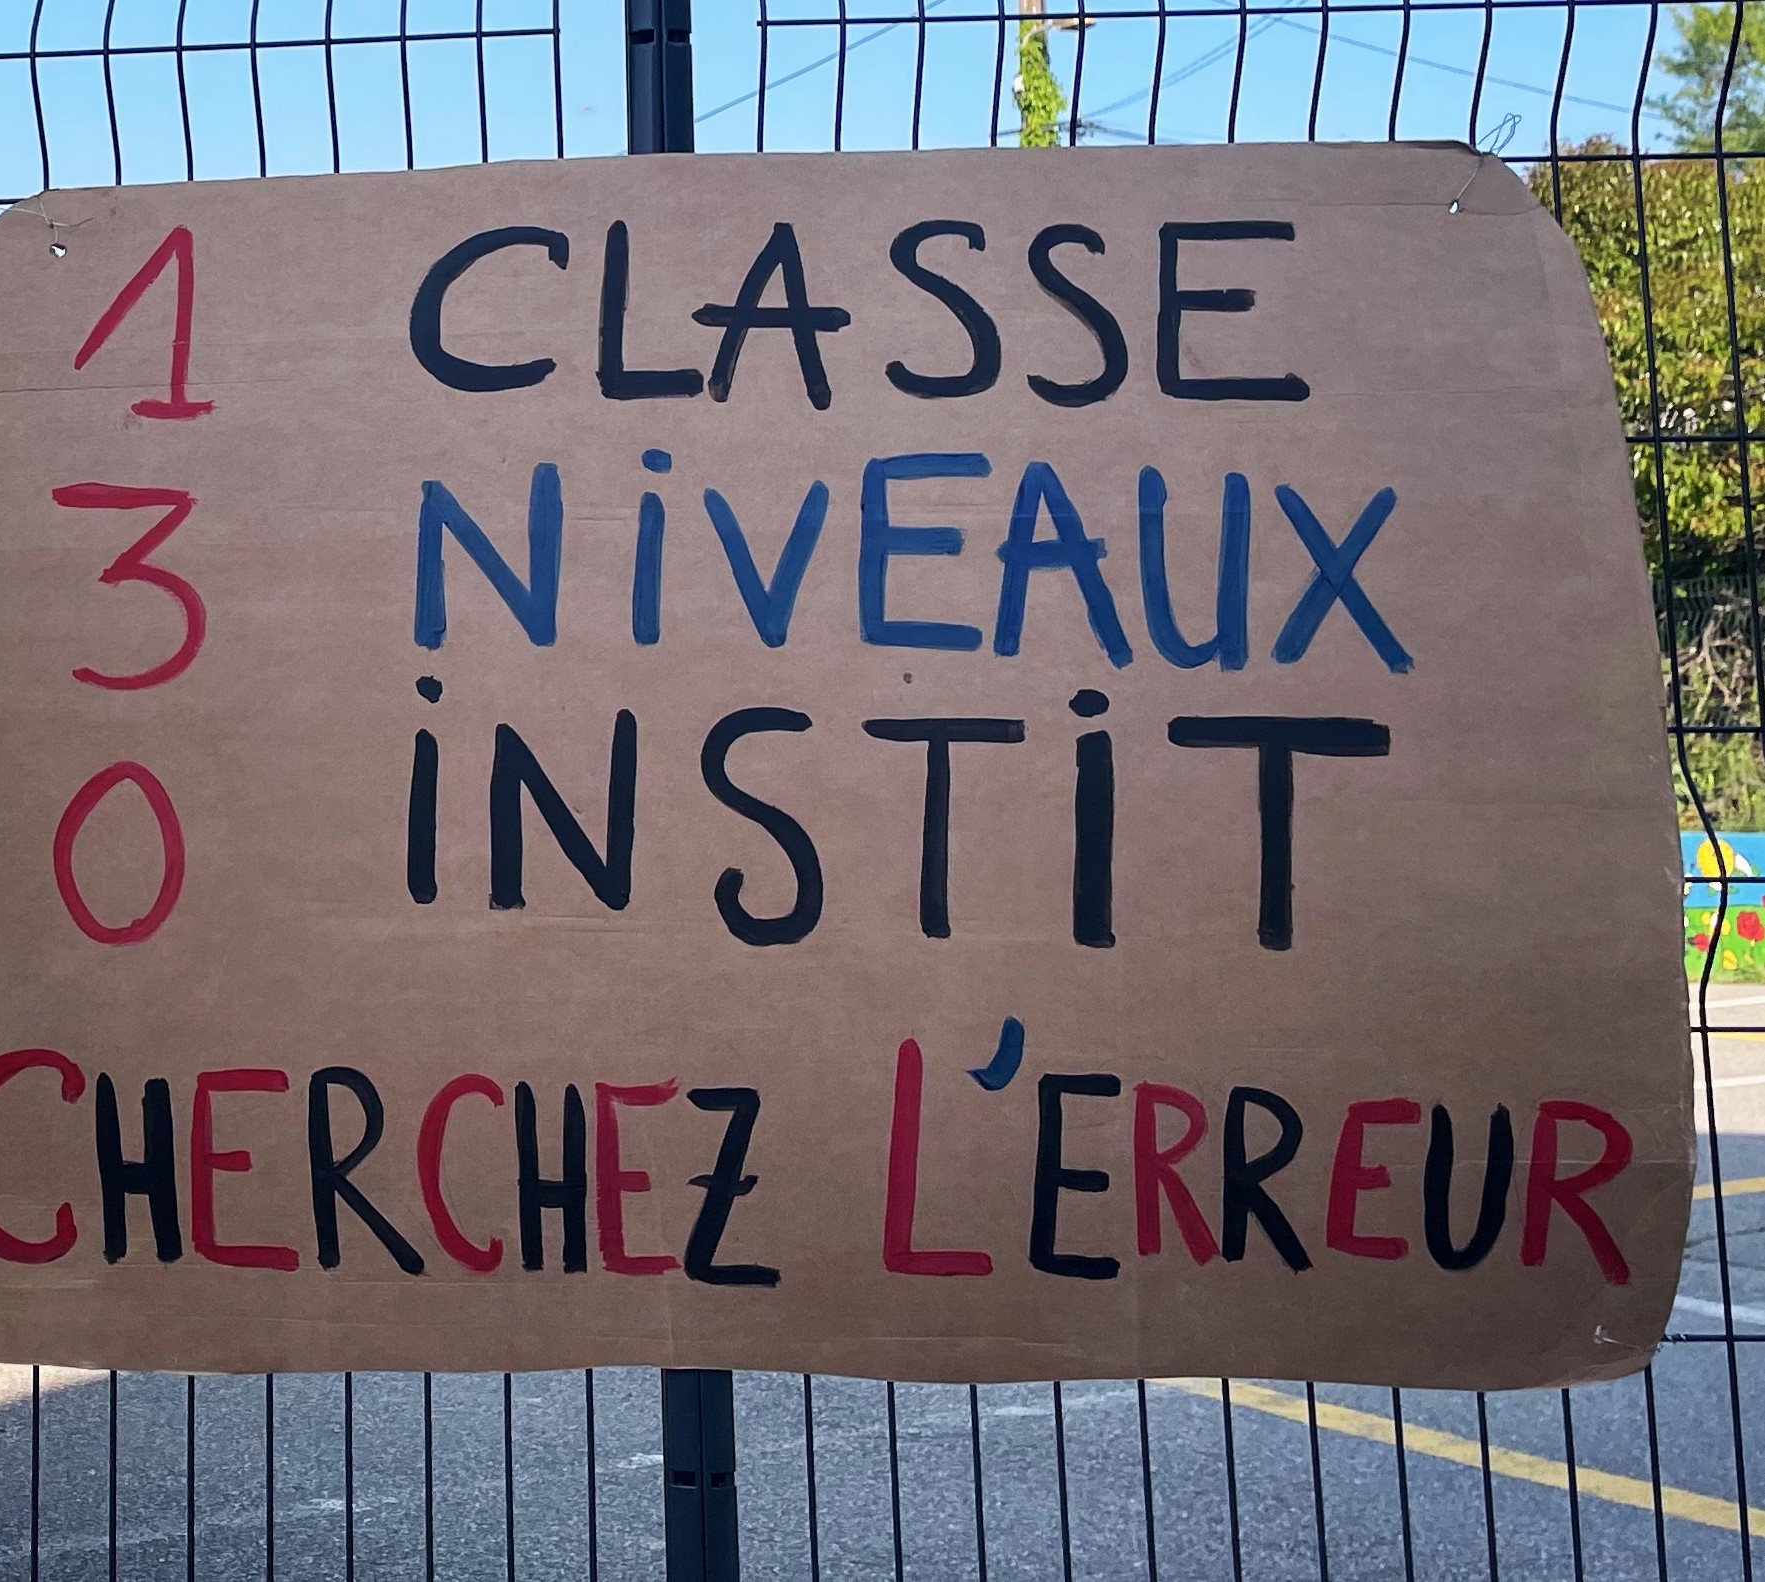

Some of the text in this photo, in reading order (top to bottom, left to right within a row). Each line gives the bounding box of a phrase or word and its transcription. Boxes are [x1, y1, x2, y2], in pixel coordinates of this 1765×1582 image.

[74, 218, 1310, 419] 1 CLASSE
[51, 482, 206, 690] 3
[883, 1014, 1633, 1286] L'ERREUR
